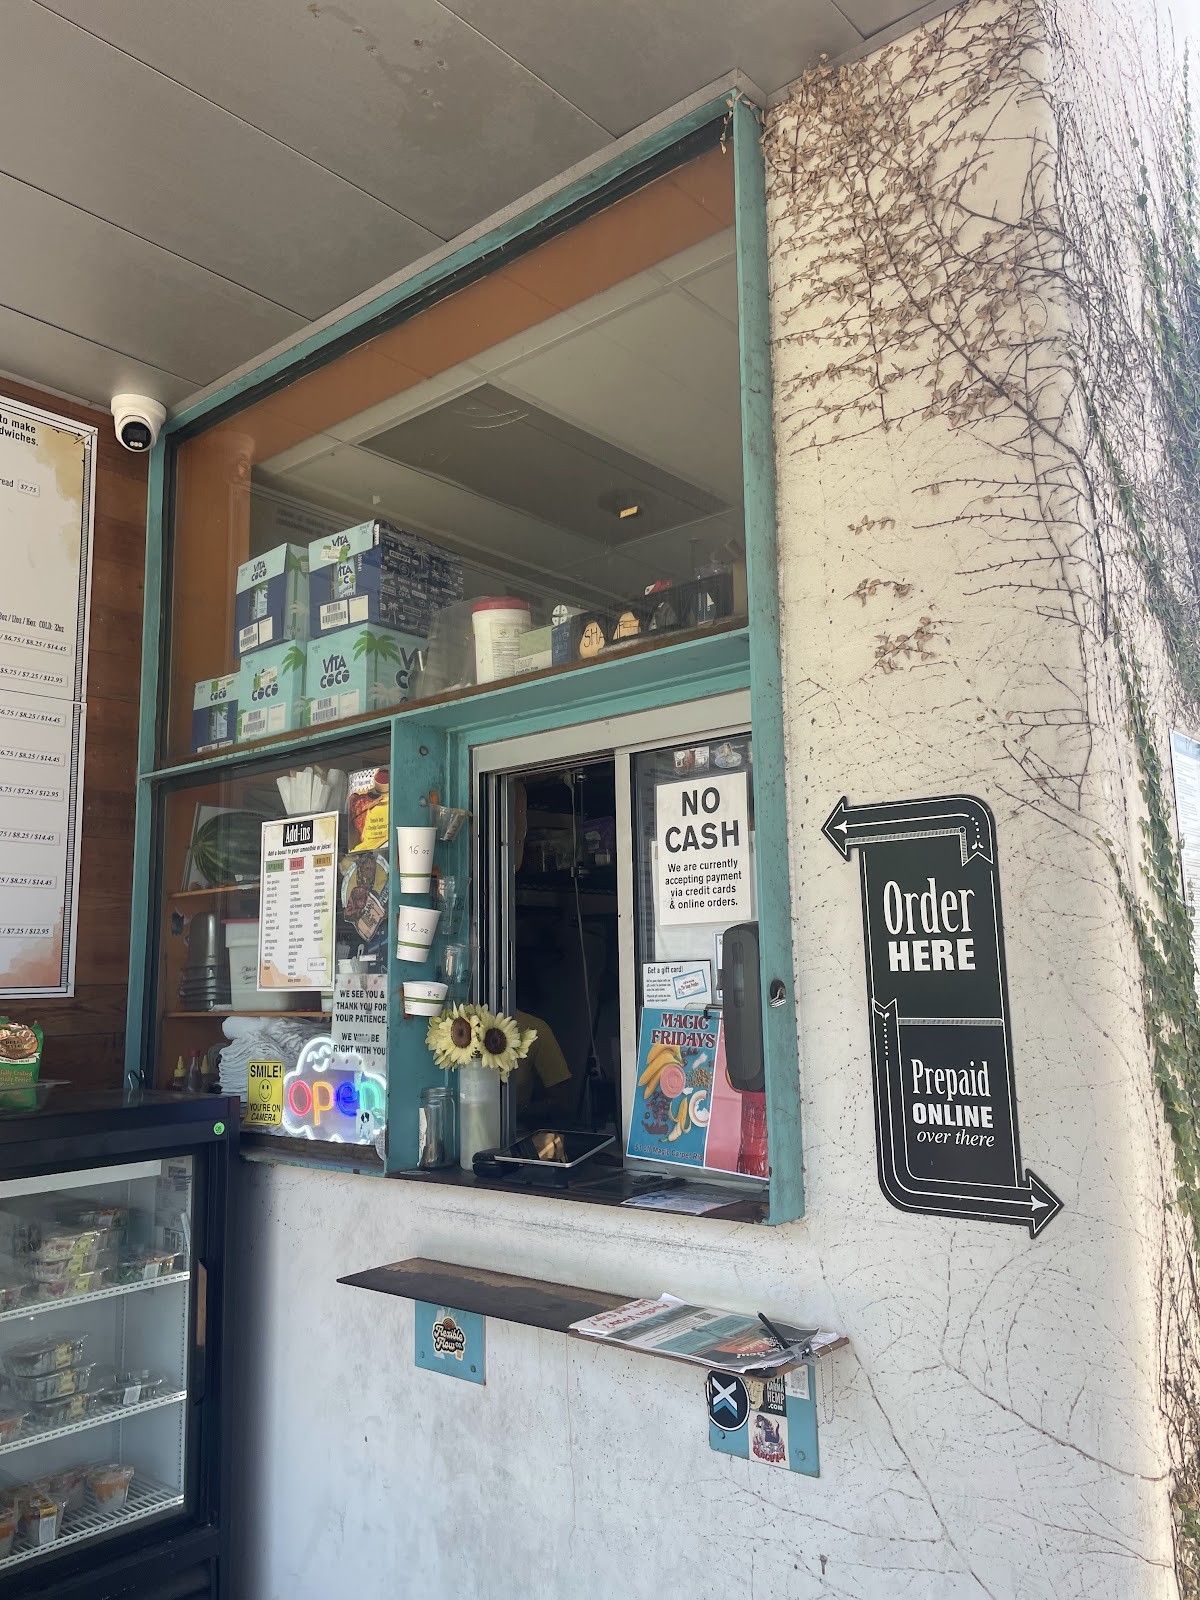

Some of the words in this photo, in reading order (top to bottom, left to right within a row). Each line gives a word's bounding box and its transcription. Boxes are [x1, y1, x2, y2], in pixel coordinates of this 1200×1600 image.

[12, 419, 36, 433] make
[0, 426, 39, 447] dwiches.
[0, 478, 14, 488] ead
[20, 483, 37, 493] $7.75
[338, 565, 353, 577] ITA
[323, 654, 347, 674] VITA
[320, 670, 349, 689] COCO
[252, 683, 278, 702] COCO
[681, 786, 721, 817] NO
[285, 824, 311, 843] Add-ins
[665, 819, 740, 854] CASH
[408, 845, 419, 855] 16
[667, 863, 681, 873] We
[683, 863, 697, 872] are
[699, 858, 738, 870] currently
[665, 874, 704, 886] accepting
[706, 870, 742, 884] payment
[670, 887, 683, 897] via
[685, 886, 710, 896] credit
[712, 884, 736, 894] cards
[669, 900, 675, 910] &
[678, 899, 705, 909] online
[707, 897, 738, 907] orders.
[883, 877, 976, 935] Order
[405, 922, 418, 933] 12
[888, 938, 976, 972] HERE
[647, 966, 656, 974] Get
[339, 990, 350, 998] WE
[351, 990, 364, 998] SEE
[366, 990, 378, 999] YOU
[380, 990, 385, 999] &
[336, 1002, 358, 1010] THANK
[360, 1002, 373, 1011] YOU
[374, 1003, 387, 1011] FOR
[335, 1014, 354, 1022] YOUR
[355, 1014, 387, 1024] PATIENCE.
[661, 1012, 710, 1030] MAGIC
[341, 1032, 351, 1041] WE
[371, 1034, 380, 1042] BE
[651, 1029, 716, 1049] FRIDAYS
[333, 1044, 354, 1053] RIGHT
[355, 1045, 372, 1055] WITH
[250, 1064, 282, 1078] SMILE!
[911, 1058, 991, 1101] Prepaid
[250, 1103, 271, 1112] YOU'RE
[272, 1104, 281, 1112] ON
[912, 1102, 994, 1128] ONLINE
[251, 1112, 276, 1122] CAMERA
[917, 1129, 951, 1144] over
[955, 1129, 995, 1147] there
[433, 1323, 464, 1341] Flexible
[435, 1337, 456, 1351] Flow
[767, 1391, 785, 1405] HEMP
